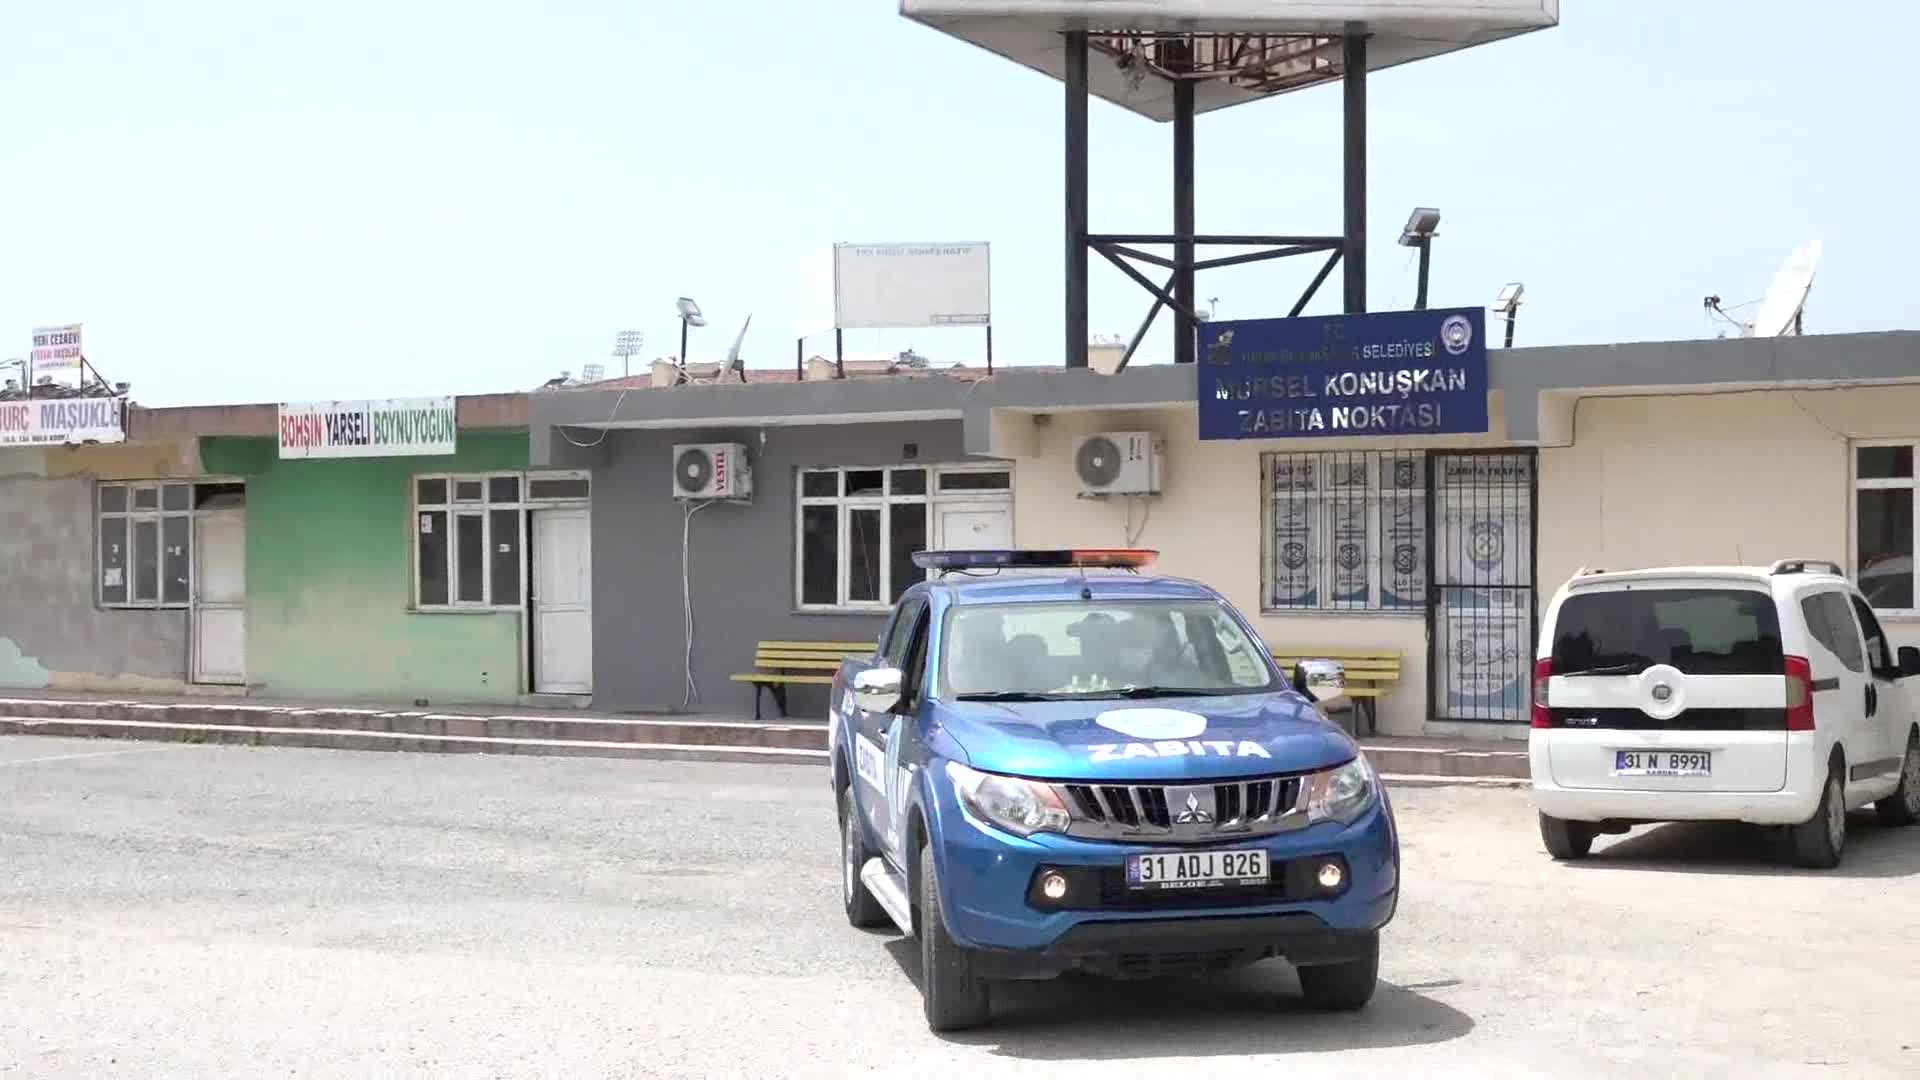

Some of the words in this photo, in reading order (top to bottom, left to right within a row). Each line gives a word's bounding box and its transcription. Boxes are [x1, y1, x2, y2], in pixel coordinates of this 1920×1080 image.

[1325, 368, 1465, 399] KONUŞKAN
[373, 401, 454, 445] BOYNUYOĞUN
[1332, 403, 1441, 429] NOKTASI
[1088, 740, 1272, 764] ZABITA
[1624, 753, 1641, 769] 31
[1647, 754, 1658, 769] N
[1669, 754, 1706, 770] 8991
[1141, 856, 1165, 880] 31
[1176, 854, 1214, 878] ADJ
[1222, 852, 1261, 876] 826
